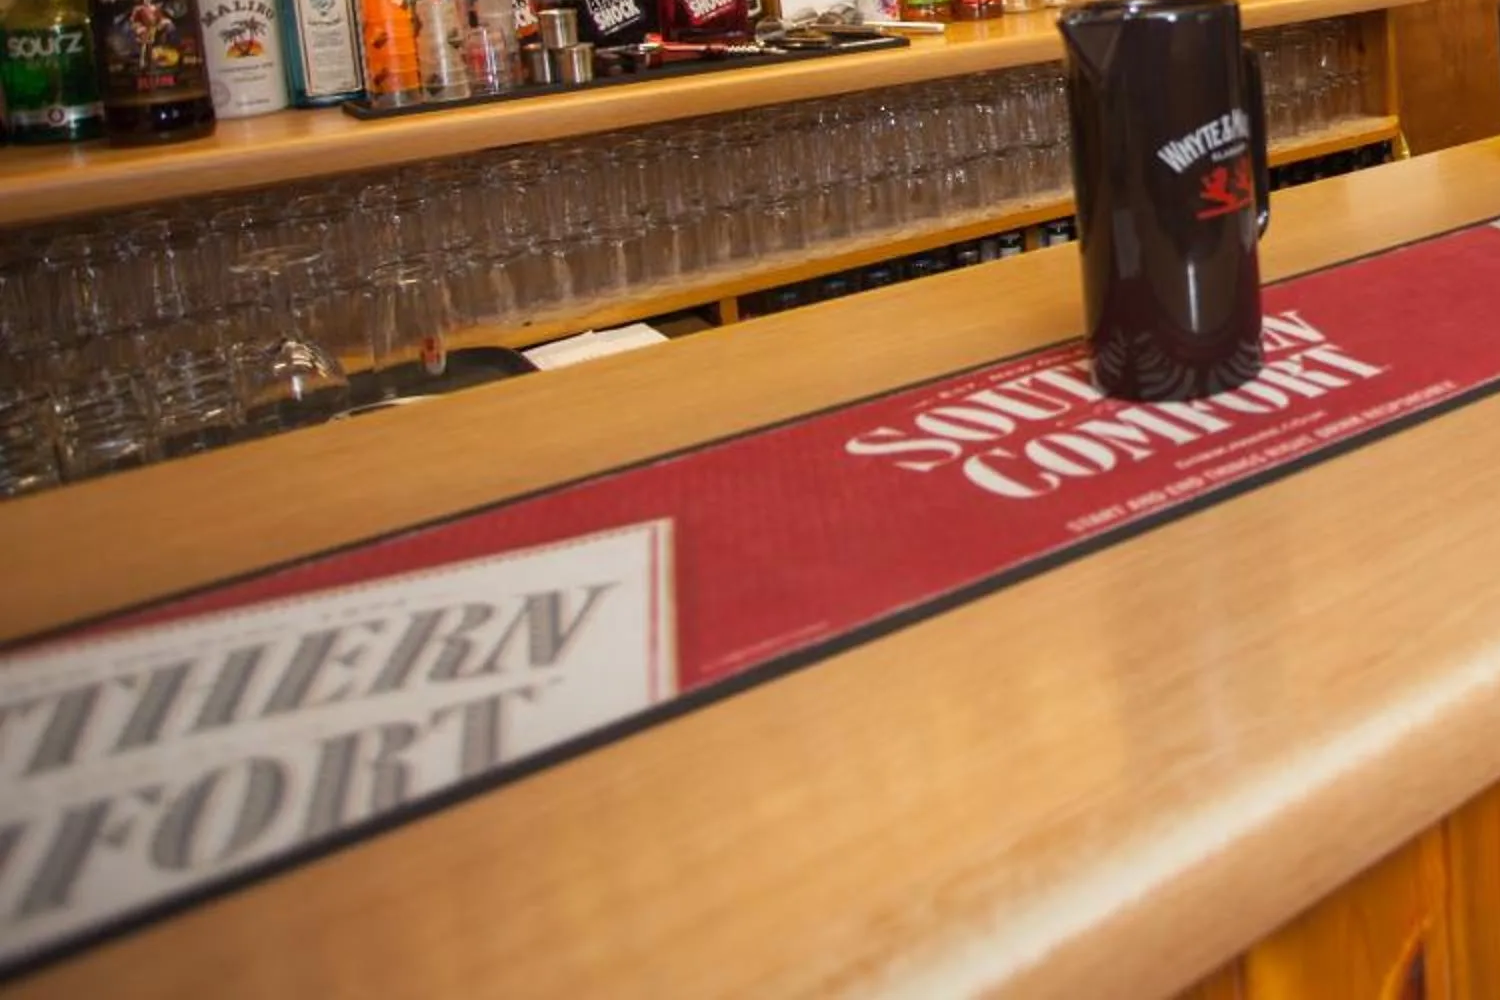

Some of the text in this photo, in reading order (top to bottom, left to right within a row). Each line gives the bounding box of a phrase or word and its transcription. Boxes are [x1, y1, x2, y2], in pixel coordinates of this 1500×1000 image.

[201, 0, 276, 28] MALIBU
[962, 344, 1393, 499] COMFORT
[0, 678, 562, 920] FORT
